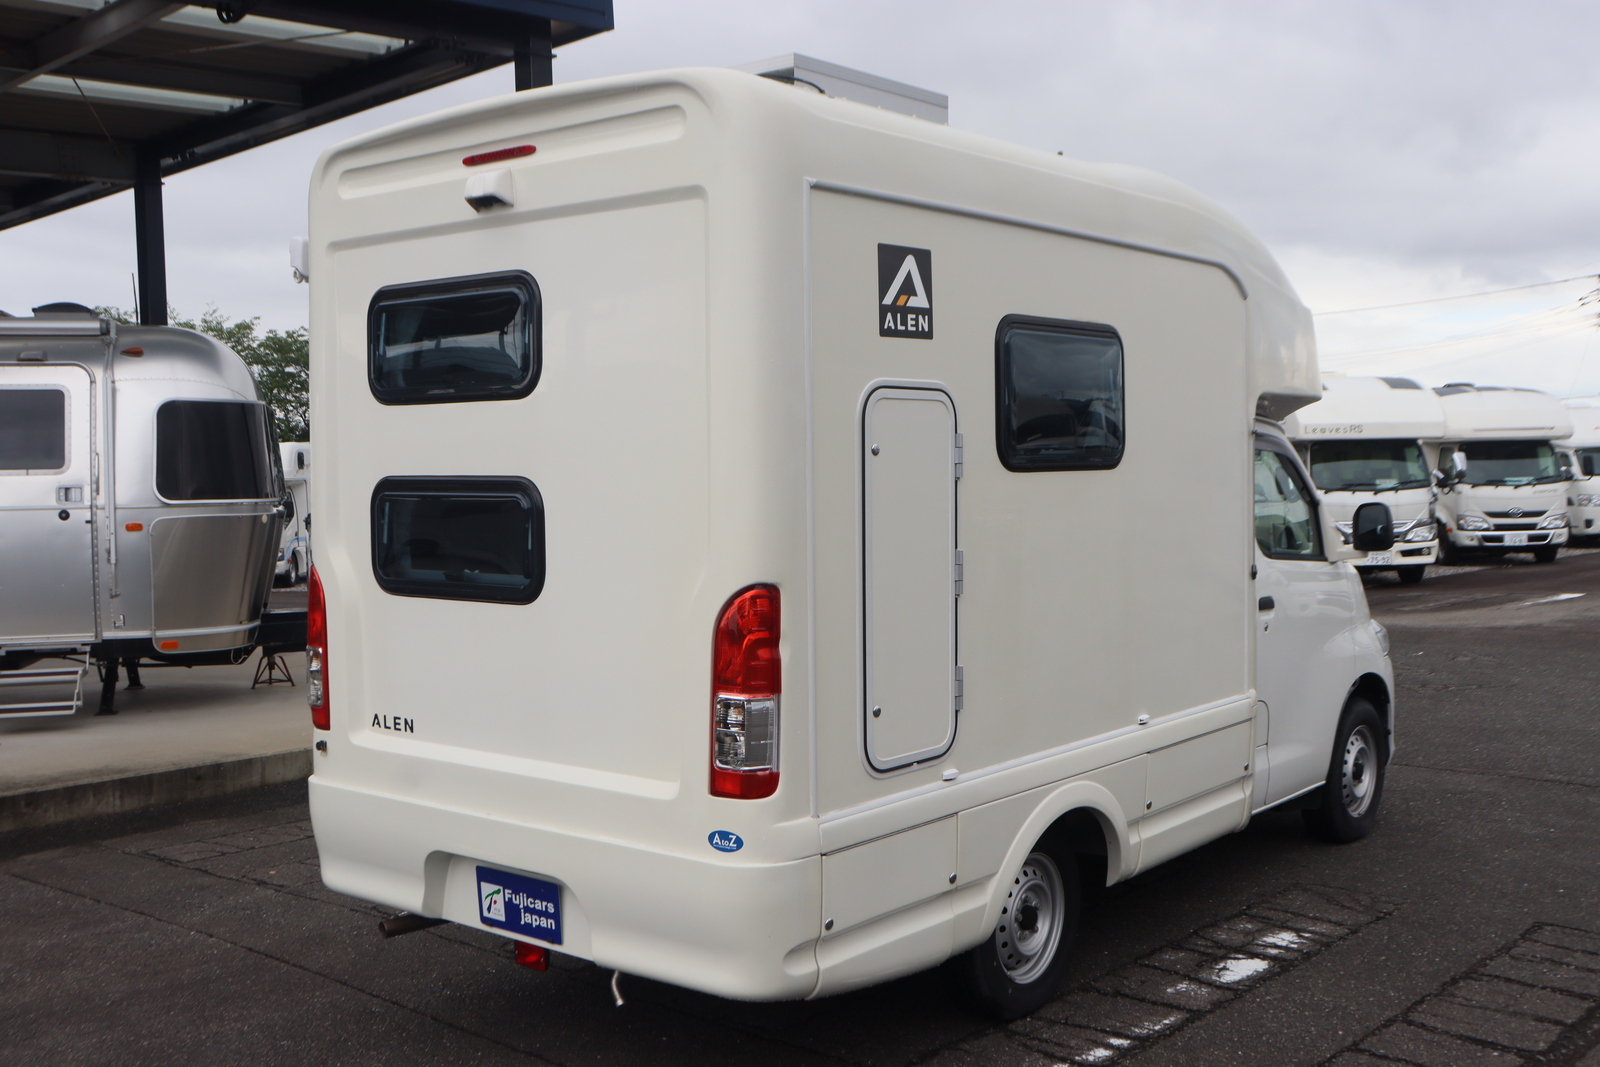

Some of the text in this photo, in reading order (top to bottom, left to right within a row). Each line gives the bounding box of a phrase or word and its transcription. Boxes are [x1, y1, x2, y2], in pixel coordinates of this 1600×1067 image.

[884, 312, 929, 332] ALEN
[372, 713, 414, 734] ALEN
[504, 889, 555, 914] Fujicars
[520, 909, 556, 930] japan
